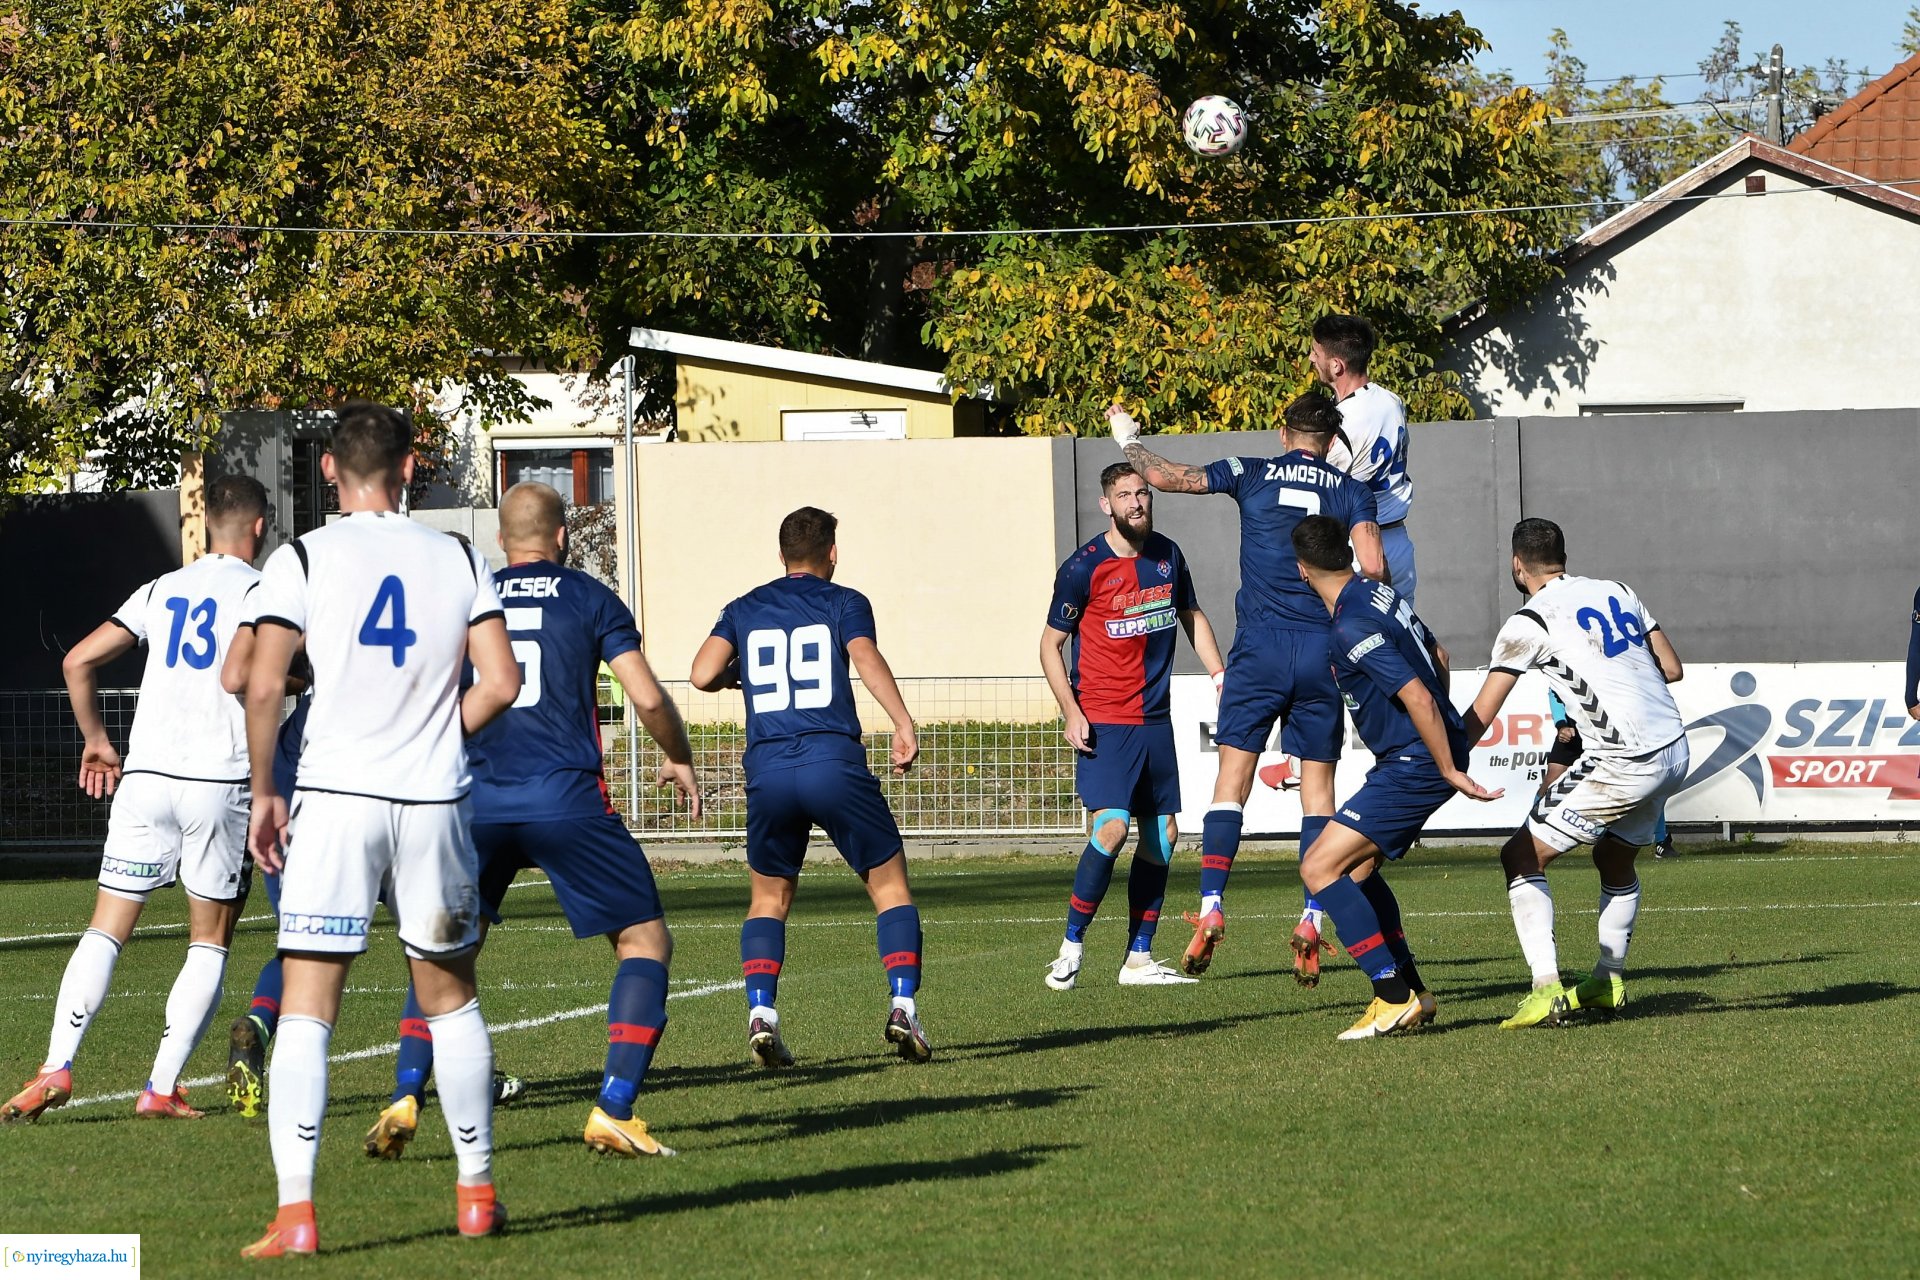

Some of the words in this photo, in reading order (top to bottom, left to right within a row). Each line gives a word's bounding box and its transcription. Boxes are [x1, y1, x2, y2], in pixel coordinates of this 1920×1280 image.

[165, 596, 217, 670] 13
[358, 574, 417, 668] 4
[1576, 595, 1645, 659] 26
[747, 623, 833, 714] 99
[1489, 755, 1509, 767] the
[1527, 769, 1538, 781] is
[1784, 760, 1888, 783] SPORT
